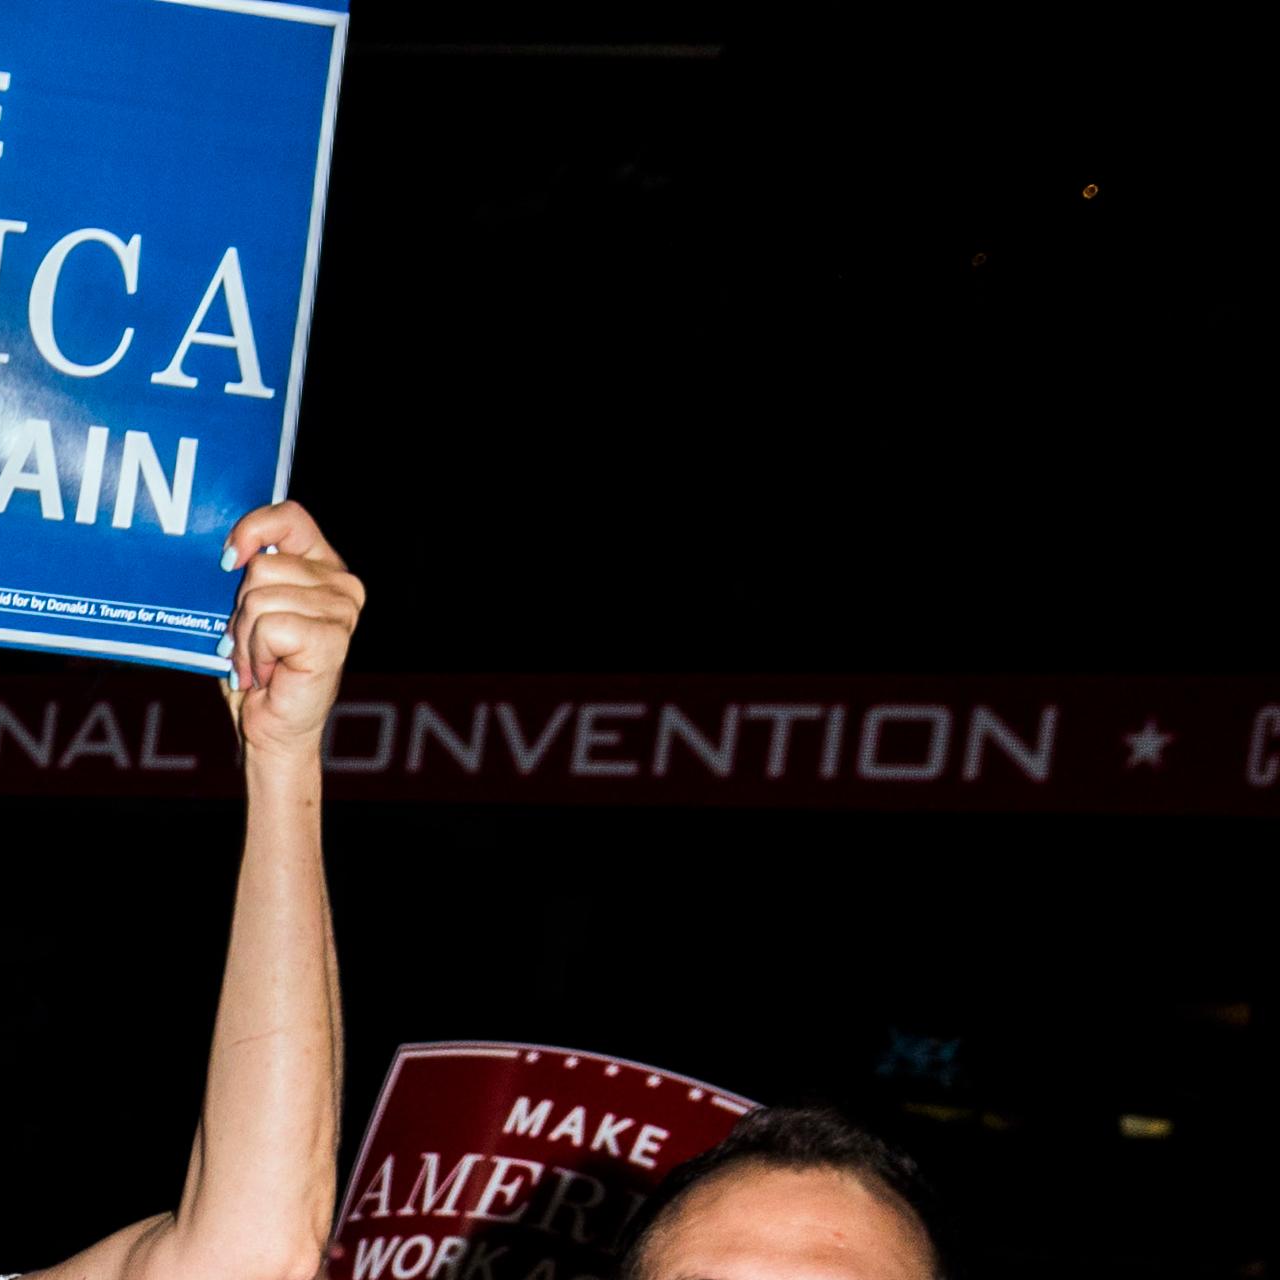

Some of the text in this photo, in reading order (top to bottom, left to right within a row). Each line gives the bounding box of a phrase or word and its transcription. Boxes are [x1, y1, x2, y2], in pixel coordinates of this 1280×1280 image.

[12, 594, 30, 608] for
[30, 596, 45, 611] by
[46, 599, 87, 615] Donald
[88, 603, 97, 616] J.
[100, 604, 136, 622] Trump
[137, 608, 155, 622] for
[155, 607, 213, 632] President,
[213, 618, 227, 632] In
[323, 701, 1059, 780] ONVENTION
[502, 1095, 671, 1171] MAKE
[347, 1151, 648, 1257] AMERI
